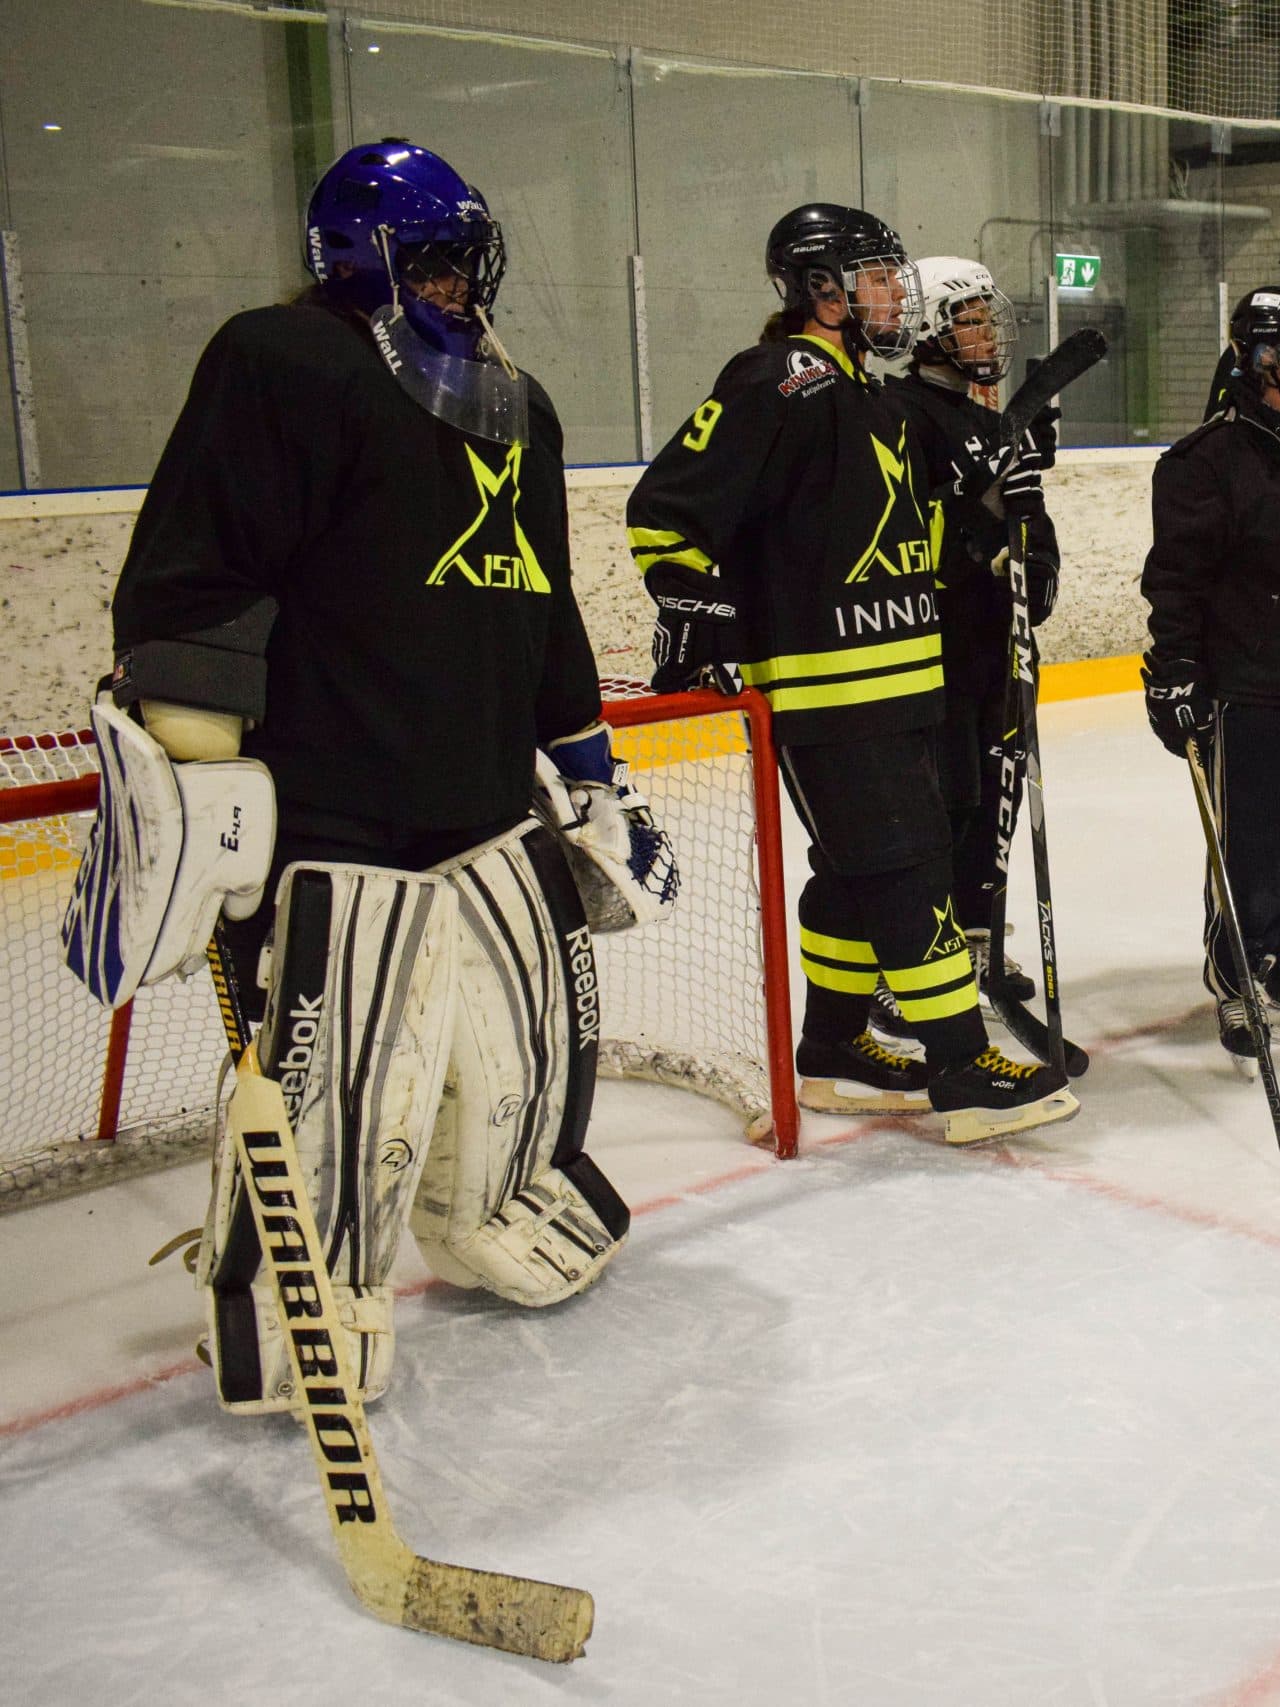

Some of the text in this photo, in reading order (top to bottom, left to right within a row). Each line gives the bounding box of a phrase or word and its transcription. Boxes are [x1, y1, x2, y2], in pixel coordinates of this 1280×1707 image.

[682, 399, 724, 453] 9
[1009, 558, 1035, 686] CCM
[1146, 681, 1195, 701] CM
[995, 755, 1016, 874] CCM
[565, 924, 600, 1051] Reebok
[1036, 900, 1055, 963] TACKS
[241, 1130, 378, 1528] WARRIOR
